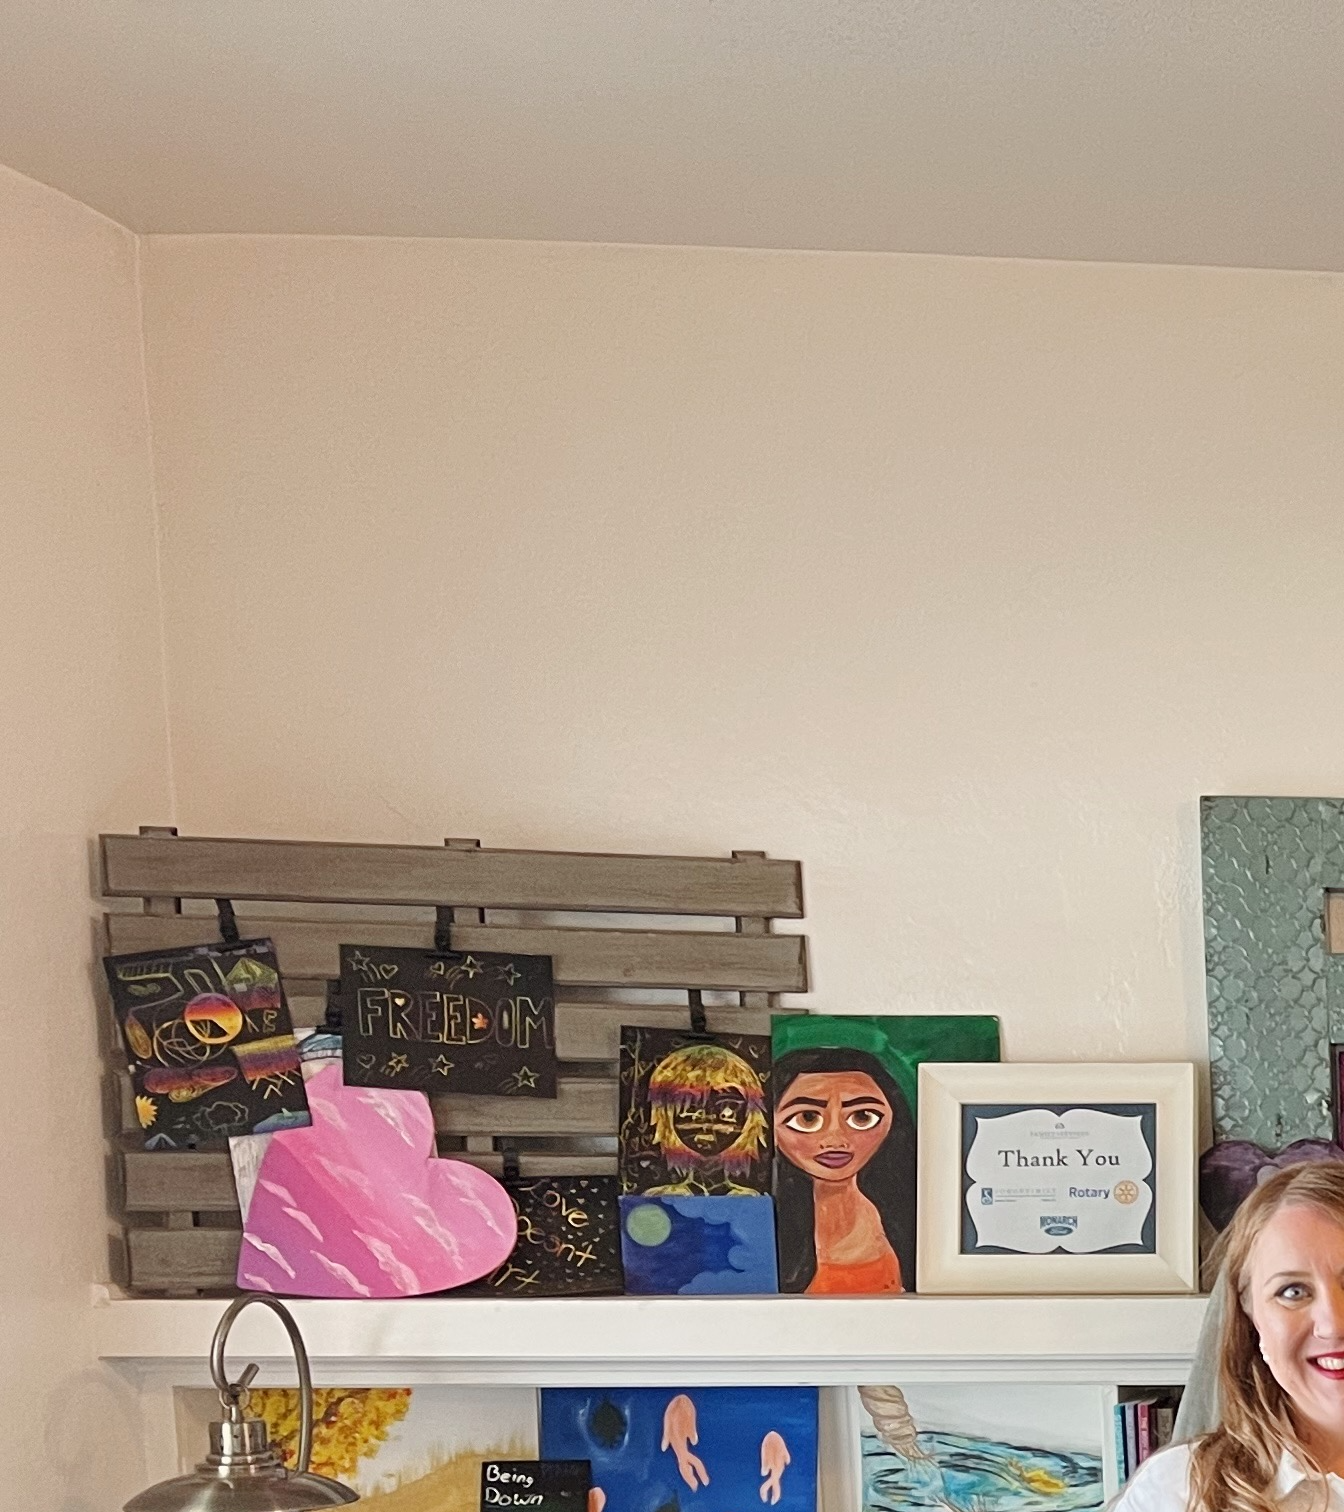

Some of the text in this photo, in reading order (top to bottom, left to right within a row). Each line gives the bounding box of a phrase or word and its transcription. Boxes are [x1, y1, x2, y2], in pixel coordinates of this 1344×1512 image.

[357, 987, 554, 1049] FREEDOM
[997, 1149, 1121, 1167] Thank You
[1068, 1187, 1110, 1199] Rotary
[486, 1464, 534, 1488] Being
[485, 1486, 544, 1506] Down
